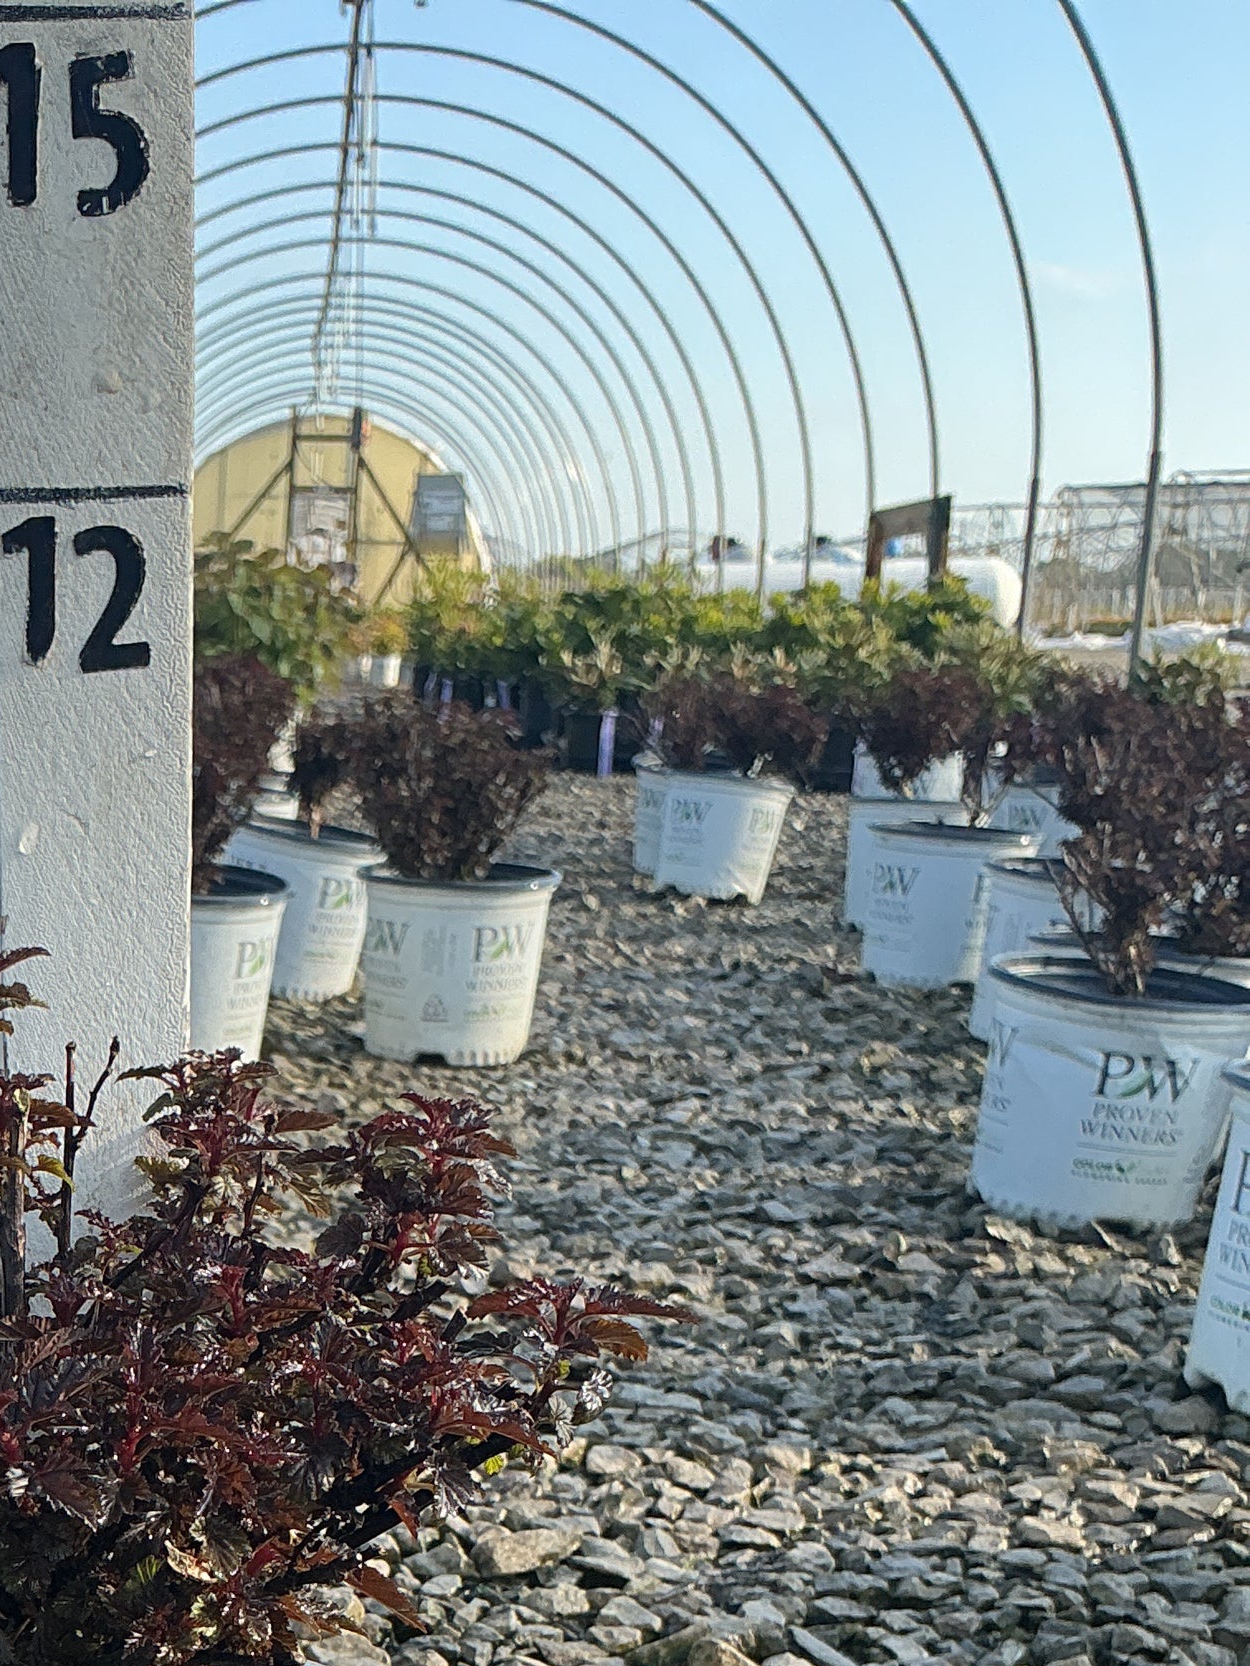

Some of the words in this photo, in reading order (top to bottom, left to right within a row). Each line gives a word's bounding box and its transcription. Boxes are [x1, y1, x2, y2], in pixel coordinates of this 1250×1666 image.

[1, 516, 151, 673] 12
[471, 922, 537, 963] PW
[1093, 1050, 1200, 1102] PW
[1092, 1102, 1179, 1125] PROVEN
